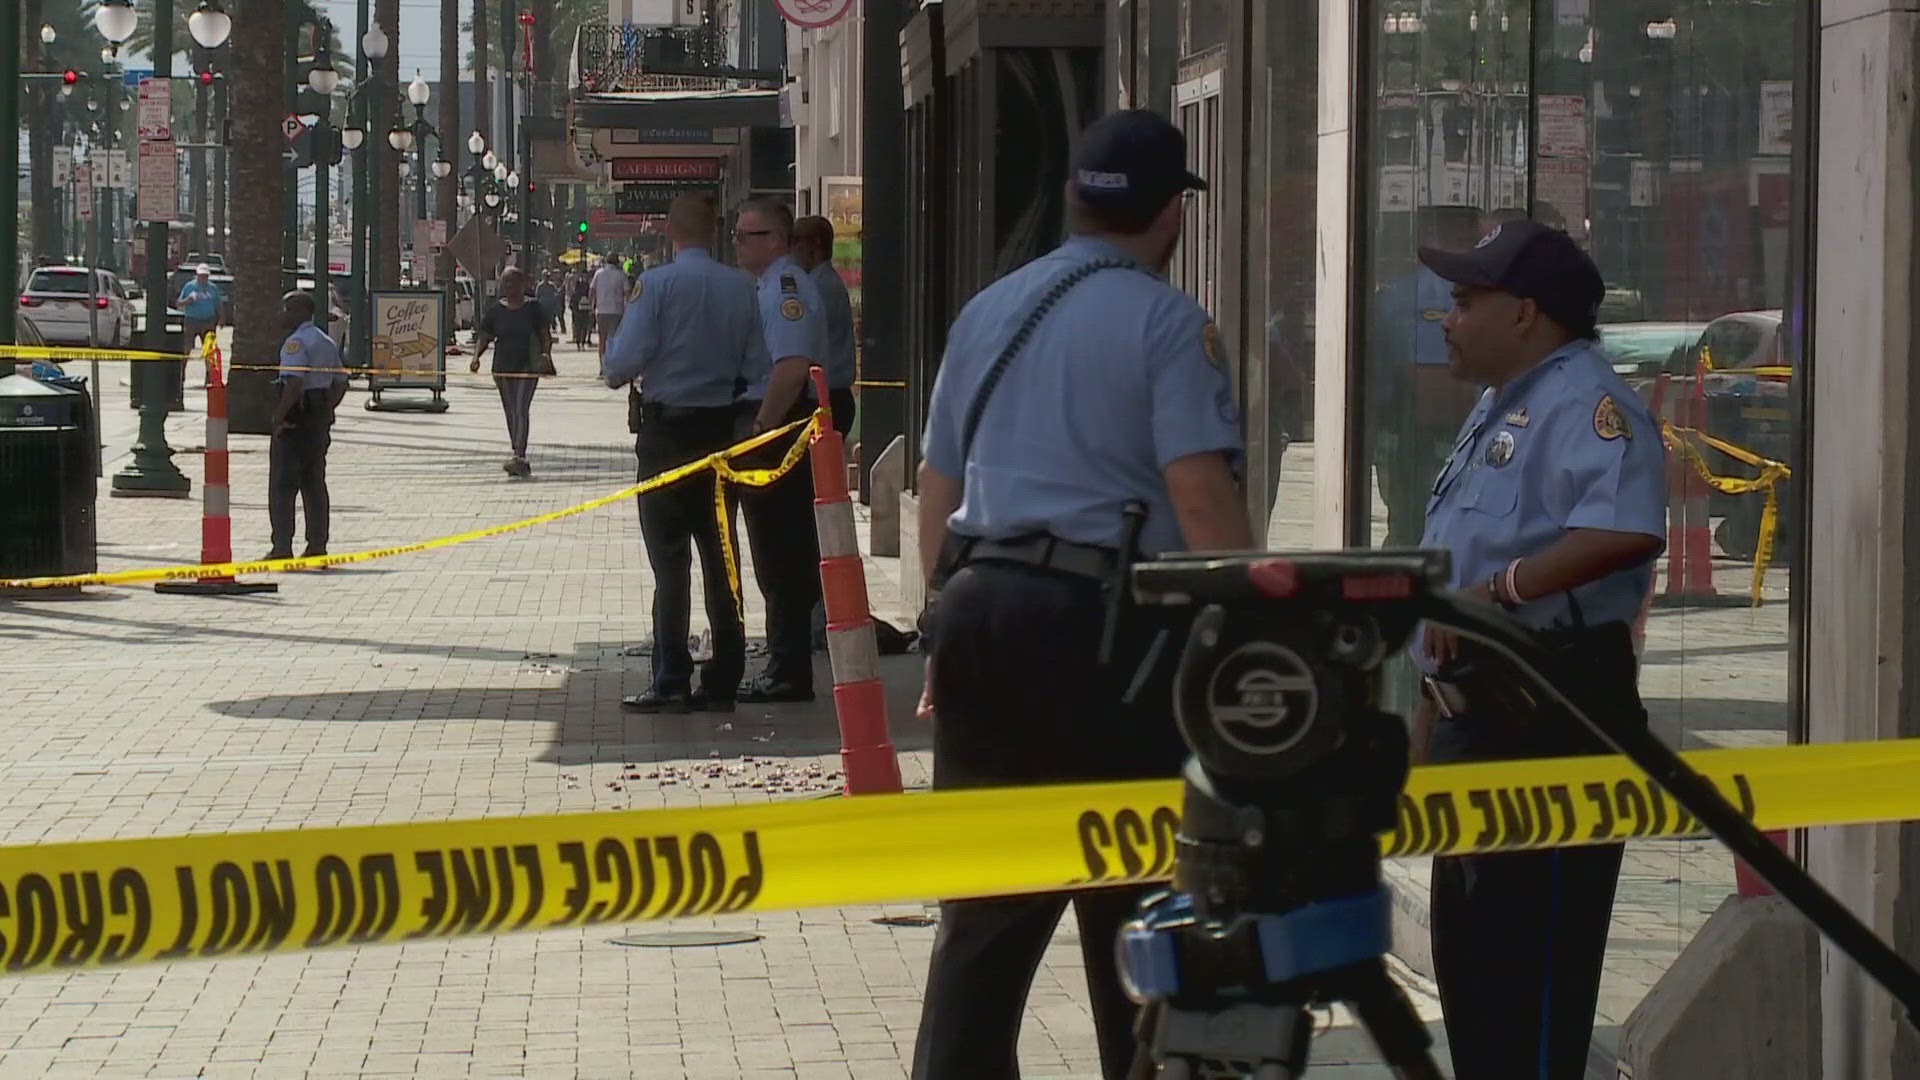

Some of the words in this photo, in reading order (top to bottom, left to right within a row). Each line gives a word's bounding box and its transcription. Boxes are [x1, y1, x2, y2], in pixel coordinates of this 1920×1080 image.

[287, 121, 297, 134] P
[655, 163, 715, 175] BEIGNET
[626, 190, 647, 201] JW
[386, 314, 426, 337] Time!
[387, 301, 431, 321] Coffee
[1467, 784, 1578, 849] LINE
[304, 853, 400, 948] DO
[403, 844, 544, 939] LINE
[548, 830, 763, 928] POLICE
[153, 859, 297, 960] NOT
